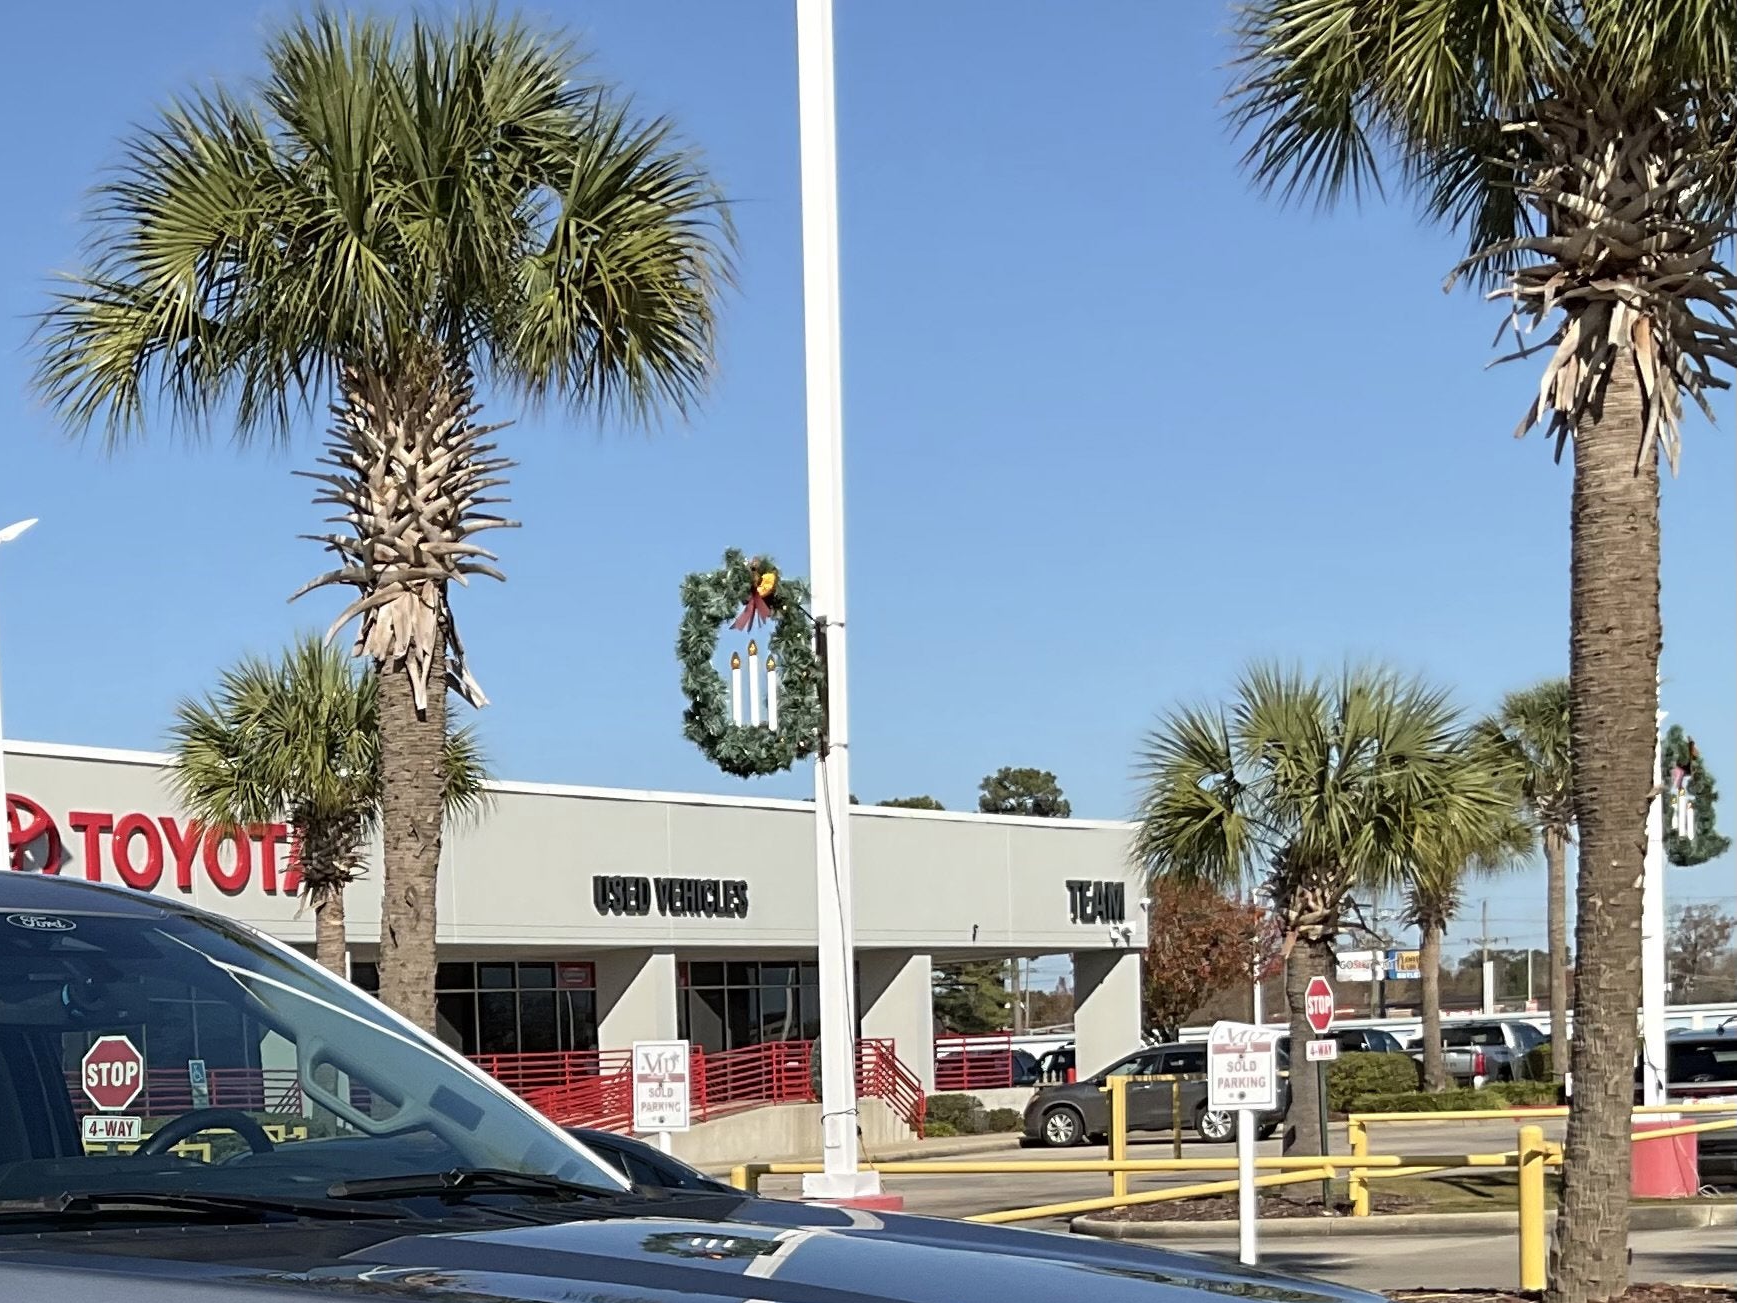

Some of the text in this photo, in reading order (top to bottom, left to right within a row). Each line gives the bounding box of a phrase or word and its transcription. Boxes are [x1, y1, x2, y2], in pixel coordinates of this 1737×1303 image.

[592, 876, 748, 918] USED VEHICLES
[1066, 880, 1125, 924] TEAM
[1307, 995, 1331, 1015] STOP
[1310, 1044, 1332, 1056] 4-WAY
[87, 1061, 139, 1087] STOP
[1227, 1061, 1257, 1072] SOLD
[1217, 1076, 1267, 1089] PARKING
[648, 1088, 674, 1098] SOLD
[641, 1102, 681, 1112] PARKING
[89, 1120, 134, 1137] 4-WAY
